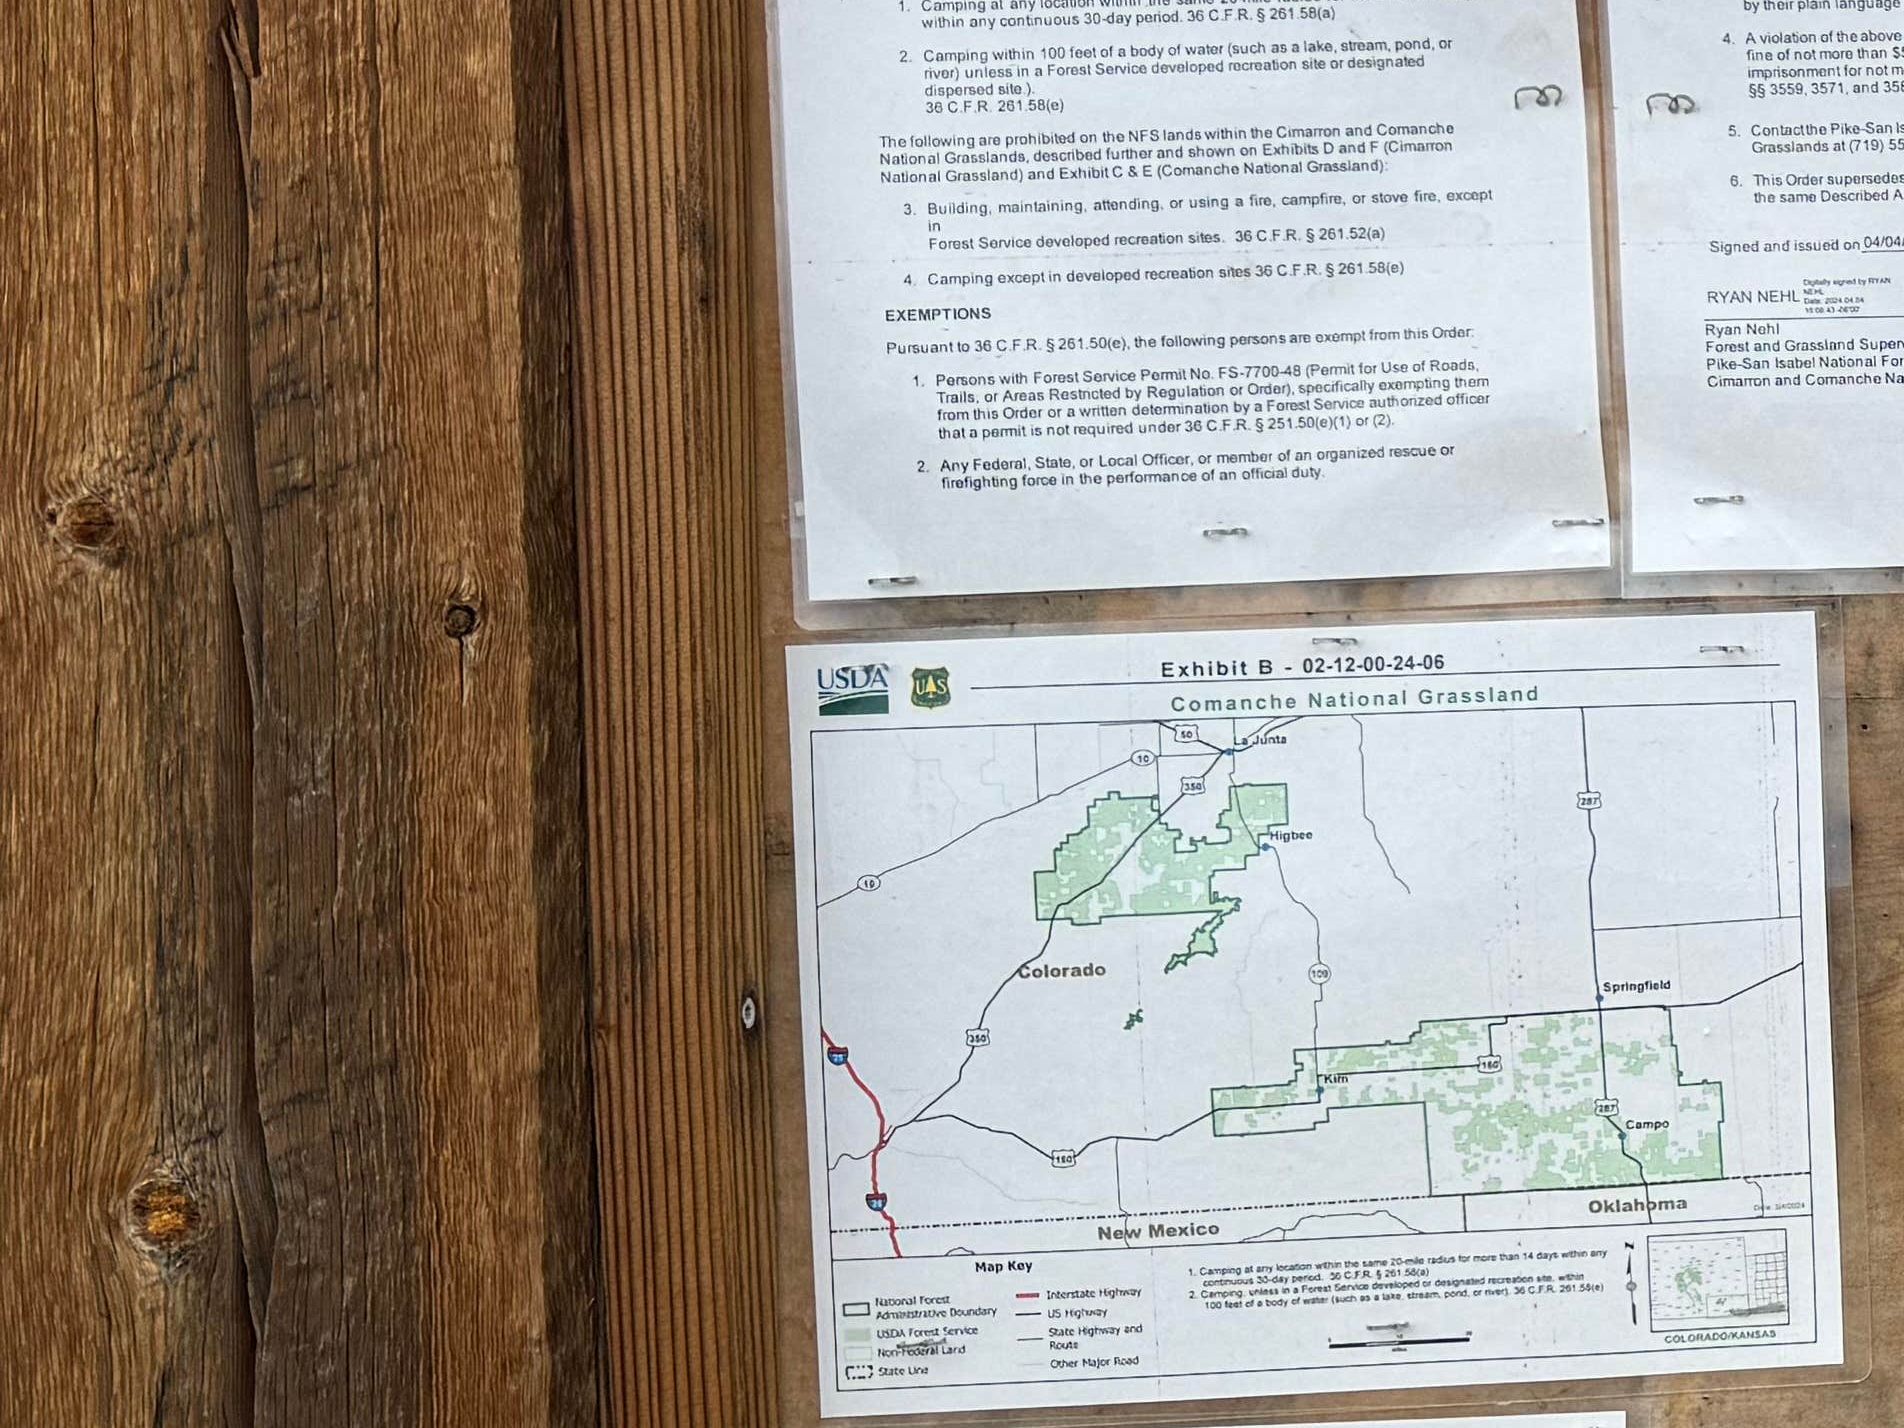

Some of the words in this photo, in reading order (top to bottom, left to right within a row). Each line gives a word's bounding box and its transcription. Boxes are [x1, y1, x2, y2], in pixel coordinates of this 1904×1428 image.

[1710, 239, 1760, 256] Signed
[1764, 239, 1791, 252] and
[1794, 238, 1840, 251] issued
[1843, 240, 1859, 251] on
[1707, 290, 1753, 303] RYAN
[1758, 289, 1800, 304] NEHL
[886, 307, 992, 322] EXEMPTIONS
[1706, 322, 1742, 338] Ryan
[1744, 322, 1780, 335] Nehl
[1706, 340, 1750, 353] Forest
[1754, 339, 1781, 352] and
[1785, 338, 1855, 351] Grassland
[1161, 661, 1248, 678] Exhibit
[1259, 660, 1273, 675] B
[1303, 654, 1445, 673] 02-12-00-24-06
[817, 667, 889, 690] USDA
[1171, 694, 1297, 712] Comanche
[1308, 689, 1407, 708] National
[1418, 684, 1538, 705] Grassland
[1019, 962, 1107, 979] Colorado
[1603, 979, 1671, 995] Springfield
[1625, 1119, 1670, 1131] Campo
[1588, 1198, 1688, 1214] Oklahoma
[1098, 1226, 1142, 1241] New
[1149, 1223, 1220, 1239] Mexico
[975, 1260, 1004, 1274] Map
[1008, 1259, 1033, 1273] Key
